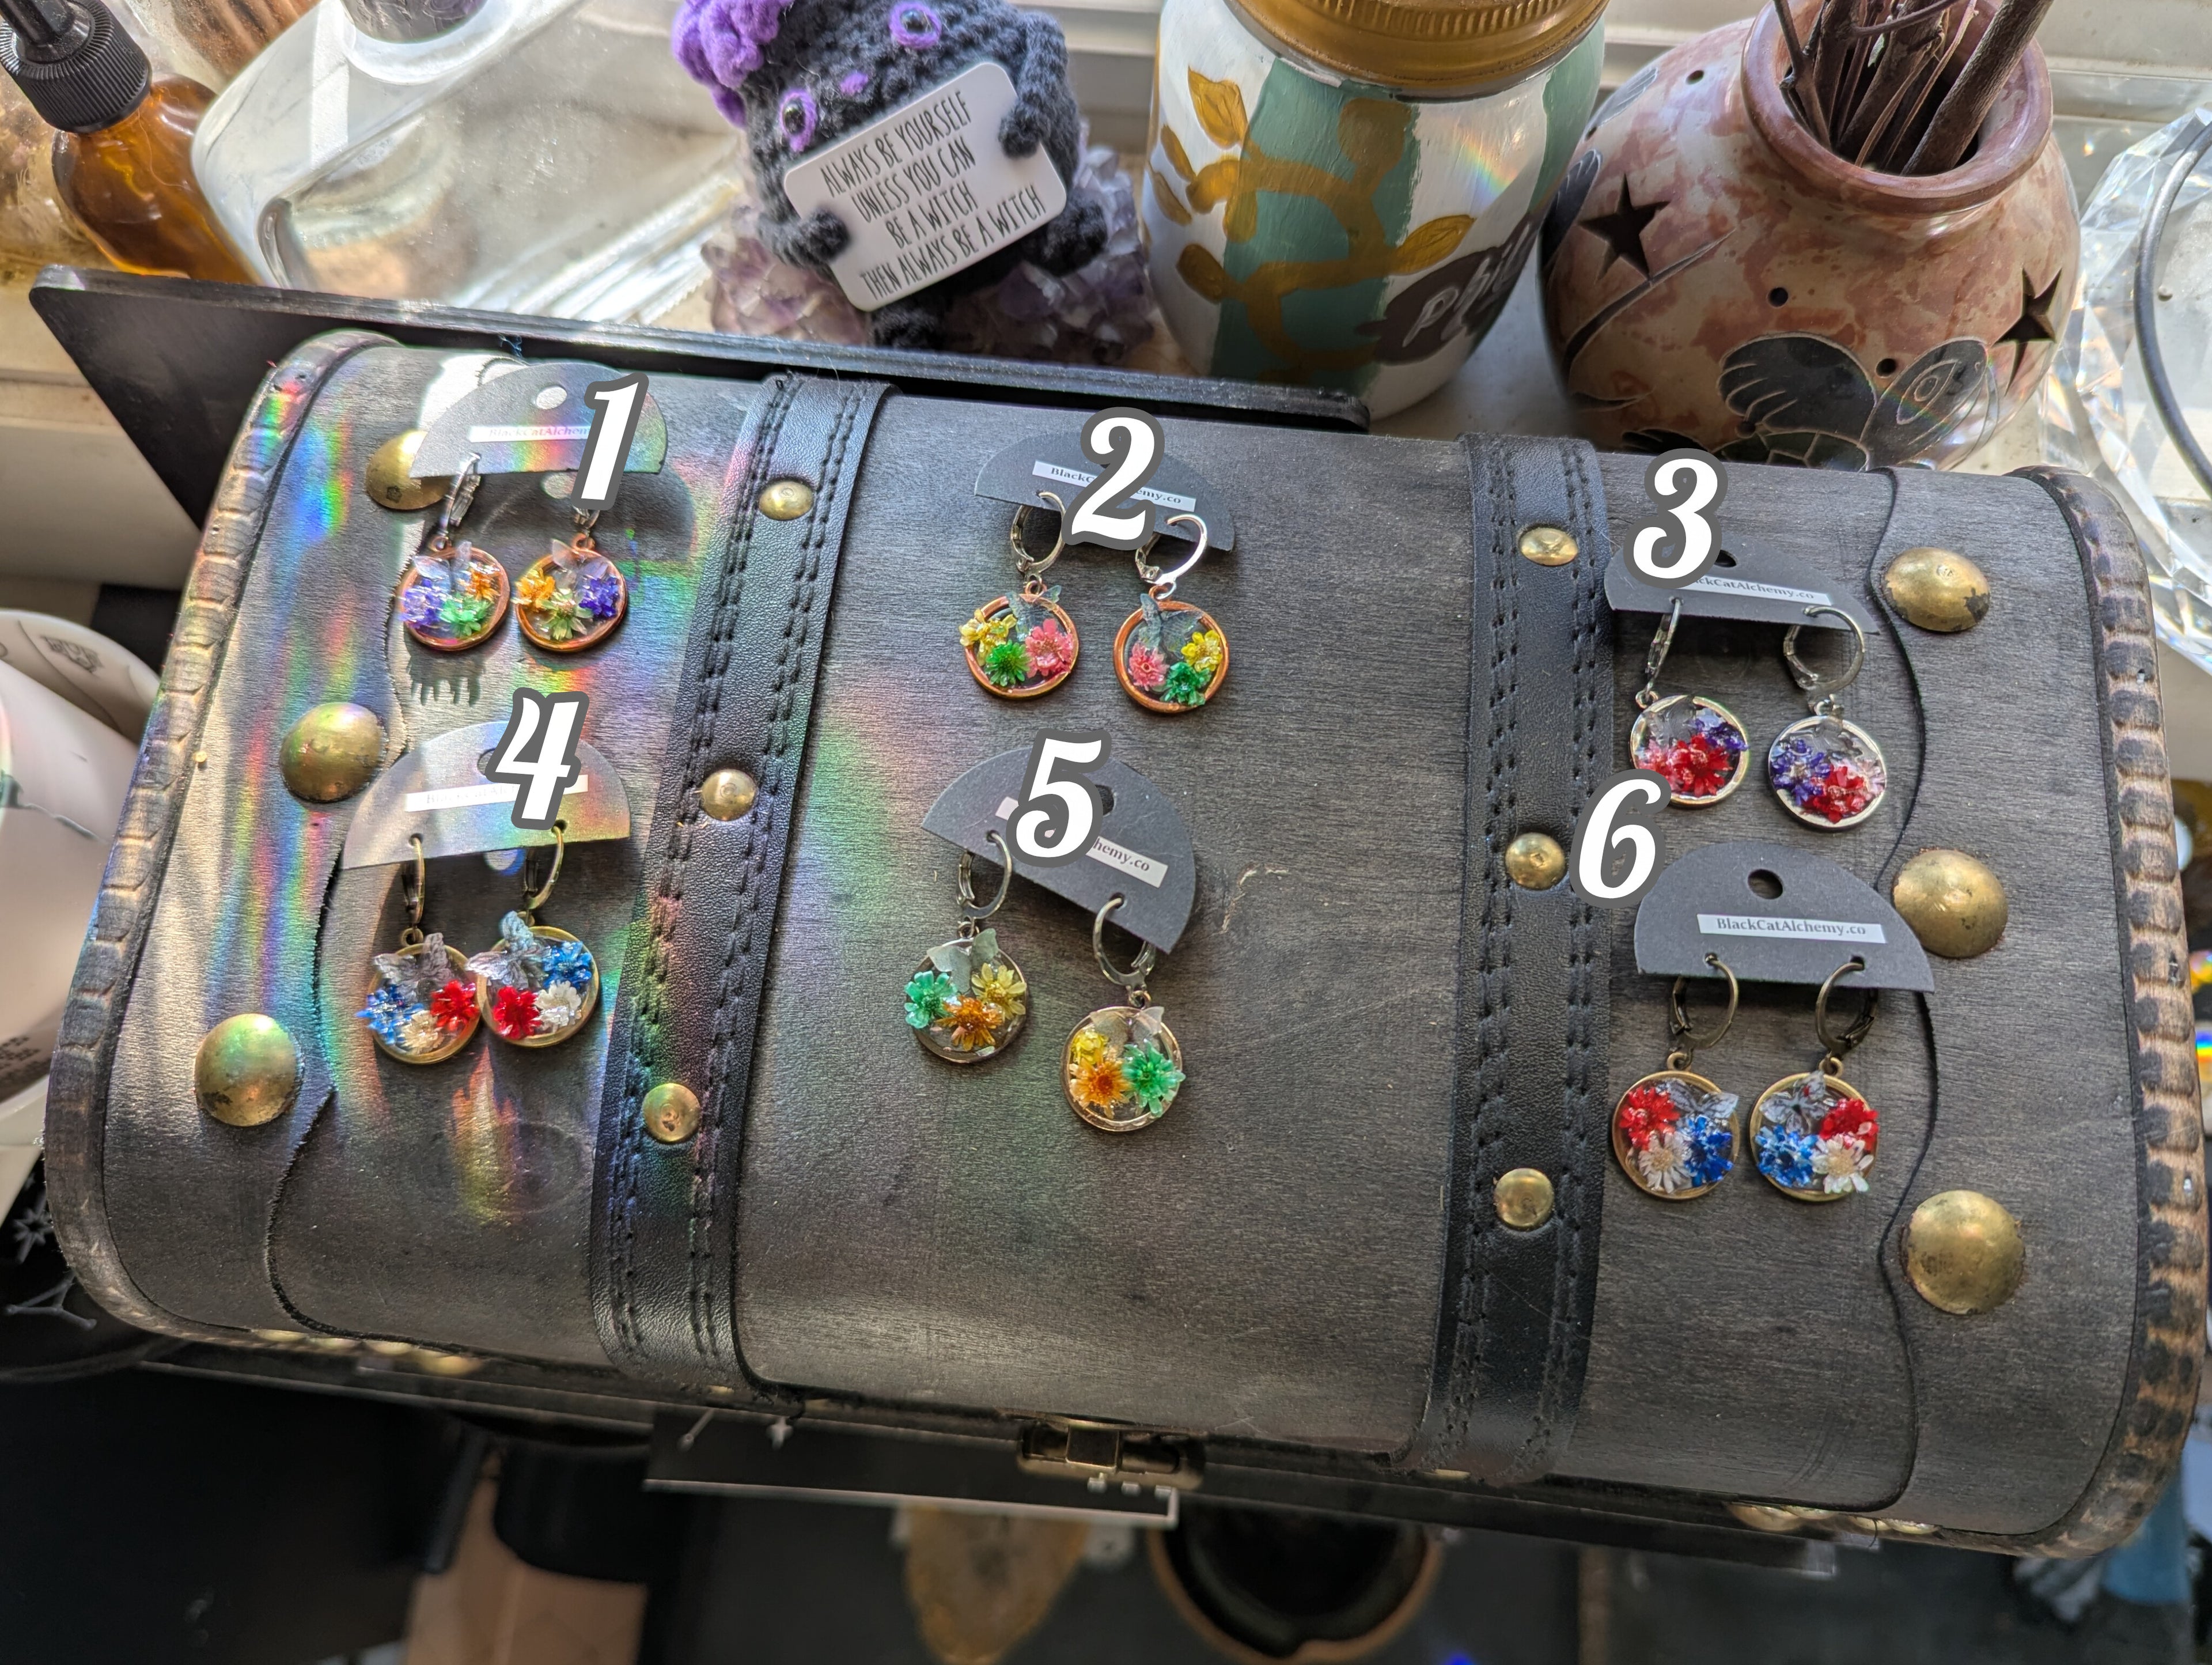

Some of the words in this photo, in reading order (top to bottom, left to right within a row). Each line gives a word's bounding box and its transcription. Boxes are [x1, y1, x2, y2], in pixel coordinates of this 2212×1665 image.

[820, 145, 881, 197] ALWAYS
[875, 133, 902, 168] BE
[895, 91, 971, 156] YOURSELF
[851, 174, 910, 223] UNLESS
[903, 154, 941, 196] YOU
[938, 137, 975, 179] CAN
[886, 217, 912, 249] BE
[908, 210, 926, 240] A
[919, 180, 978, 231] WITCH
[859, 263, 902, 300] THEN
[898, 236, 957, 285] ALWAYS
[953, 224, 979, 258] BE
[976, 217, 994, 247] A
[988, 184, 1046, 238] WITCH
[1051, 467, 1181, 504] BlackCemy.co
[1696, 577, 1815, 599] ckCatAlchemy.co
[1717, 918, 1866, 936] BlackCatAlchemy.co
